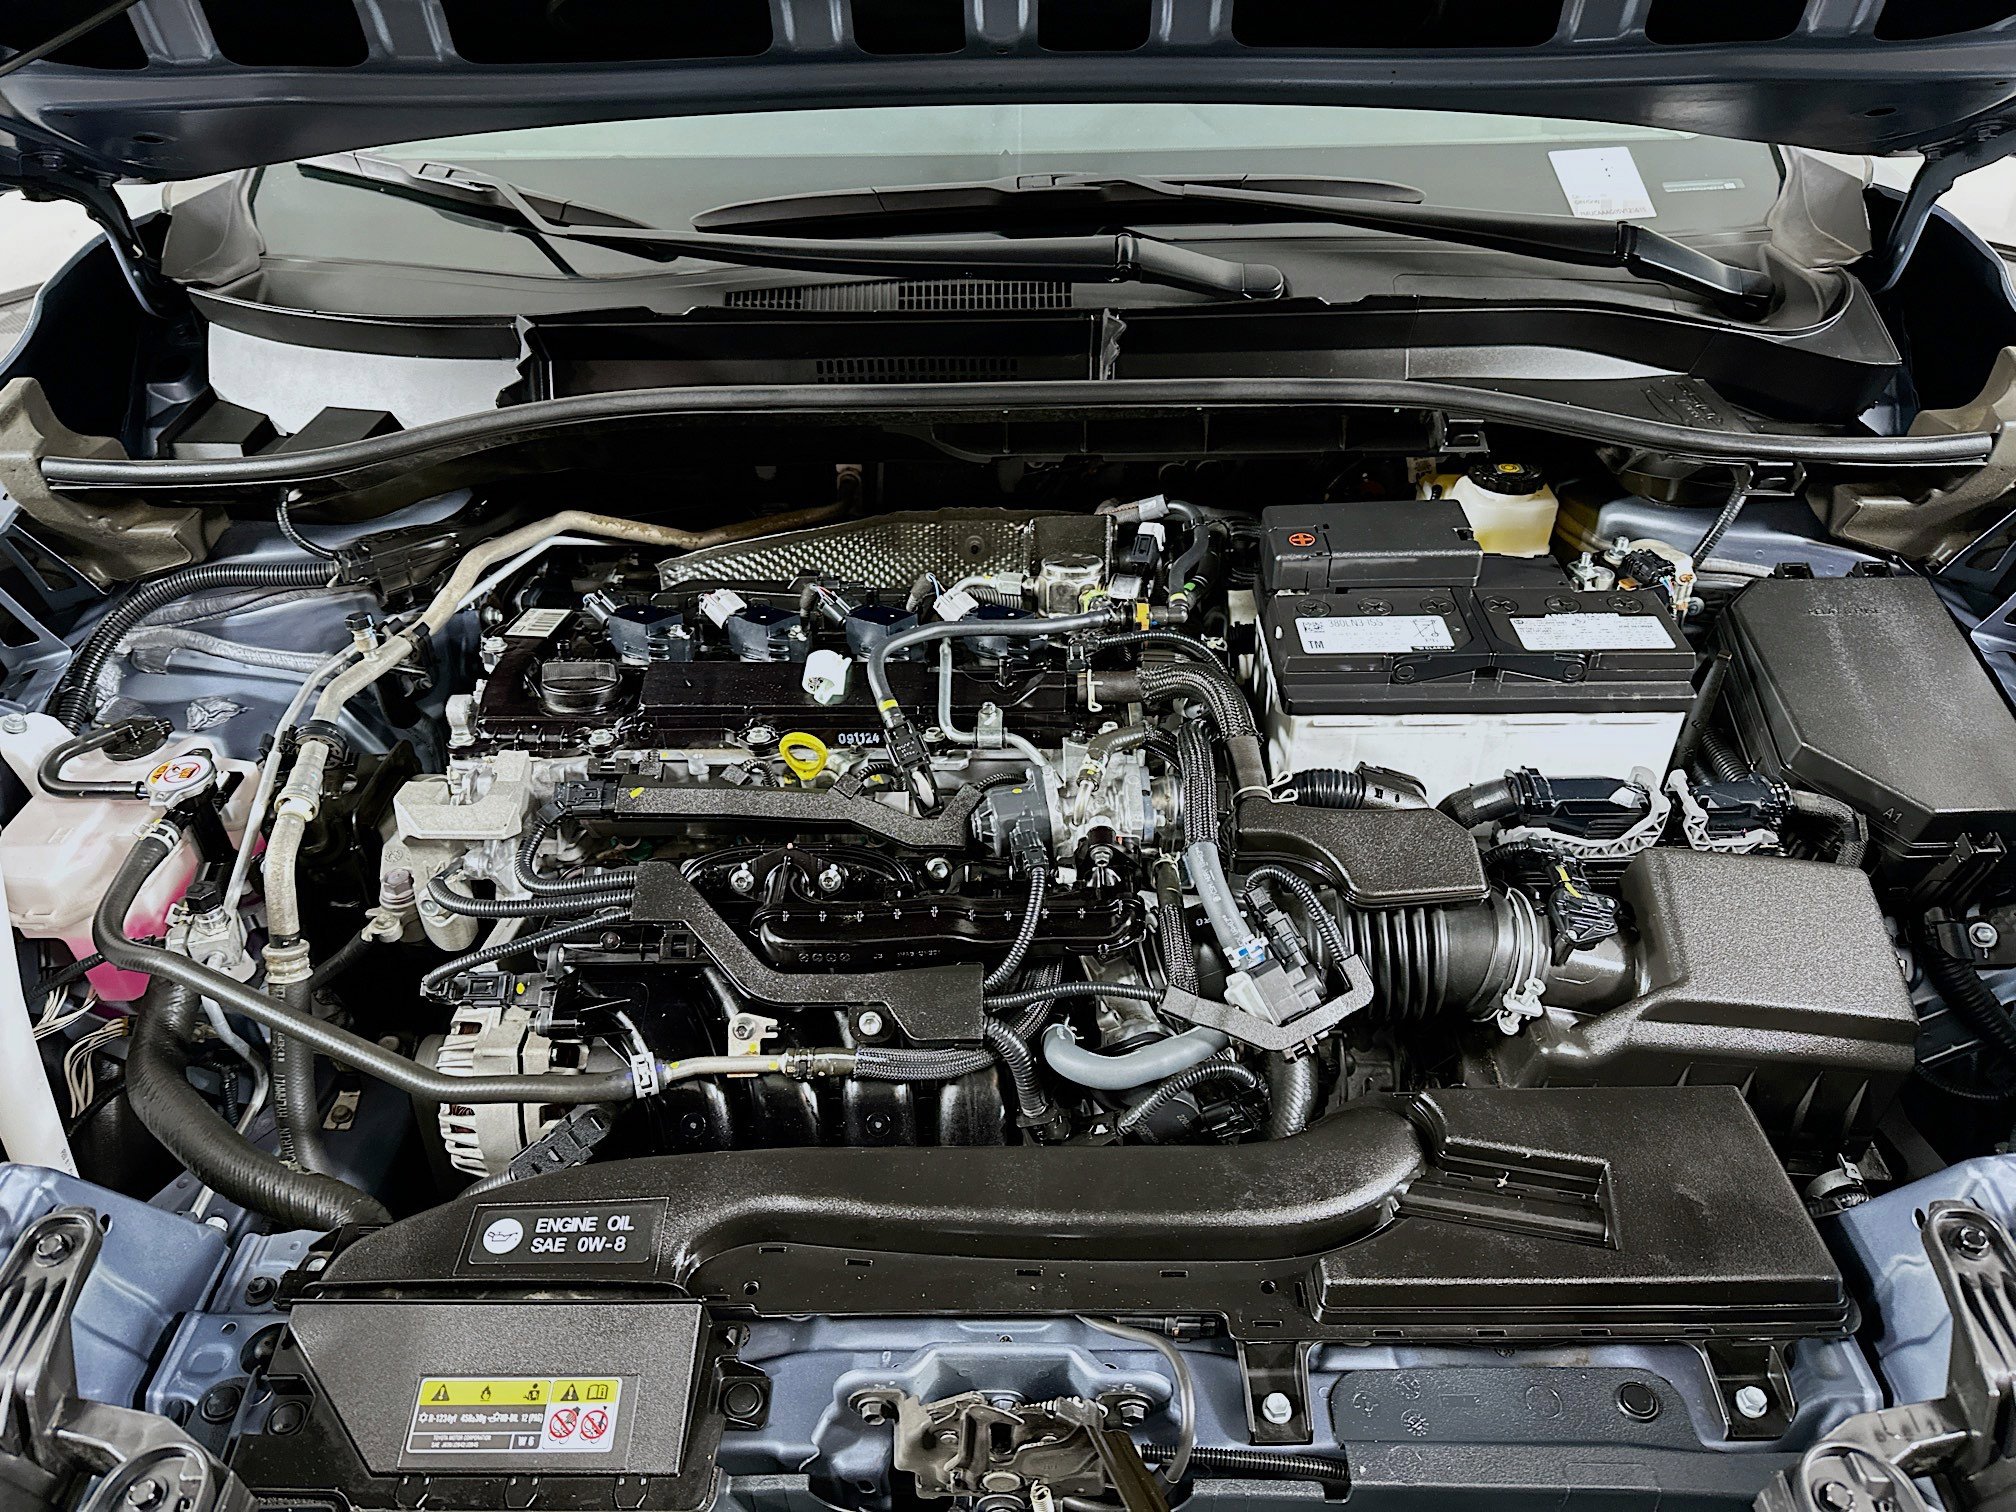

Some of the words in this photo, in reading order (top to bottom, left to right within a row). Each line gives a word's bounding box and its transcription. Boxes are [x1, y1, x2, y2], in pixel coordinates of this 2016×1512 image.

[1308, 640, 1325, 649] TM
[838, 731, 880, 745] 091124
[1882, 807, 1903, 824] A1
[278, 1127, 297, 1164] CHIRIN
[535, 1216, 599, 1233] ENGINE
[607, 1215, 635, 1231] OIL
[530, 1237, 568, 1253] SAE
[577, 1236, 626, 1252] 0W-8
[518, 1436, 527, 1446] W
